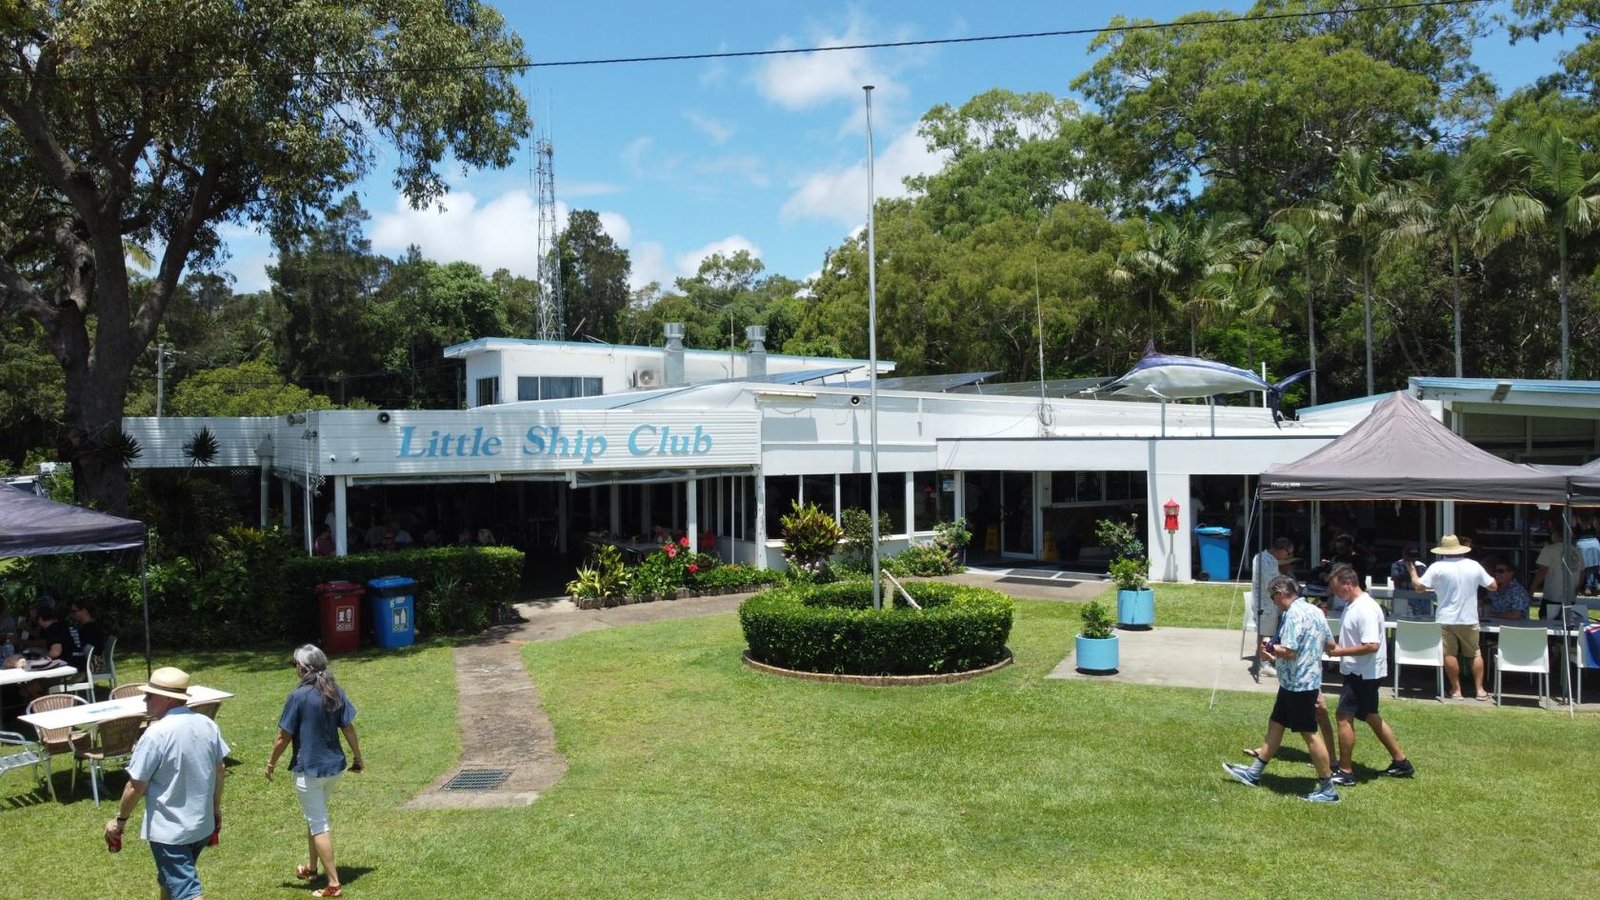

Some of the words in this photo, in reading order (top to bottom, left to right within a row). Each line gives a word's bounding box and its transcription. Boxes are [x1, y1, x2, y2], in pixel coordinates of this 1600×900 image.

[396, 426, 502, 458] Little
[523, 425, 607, 464] Ship
[628, 424, 713, 456] Club
